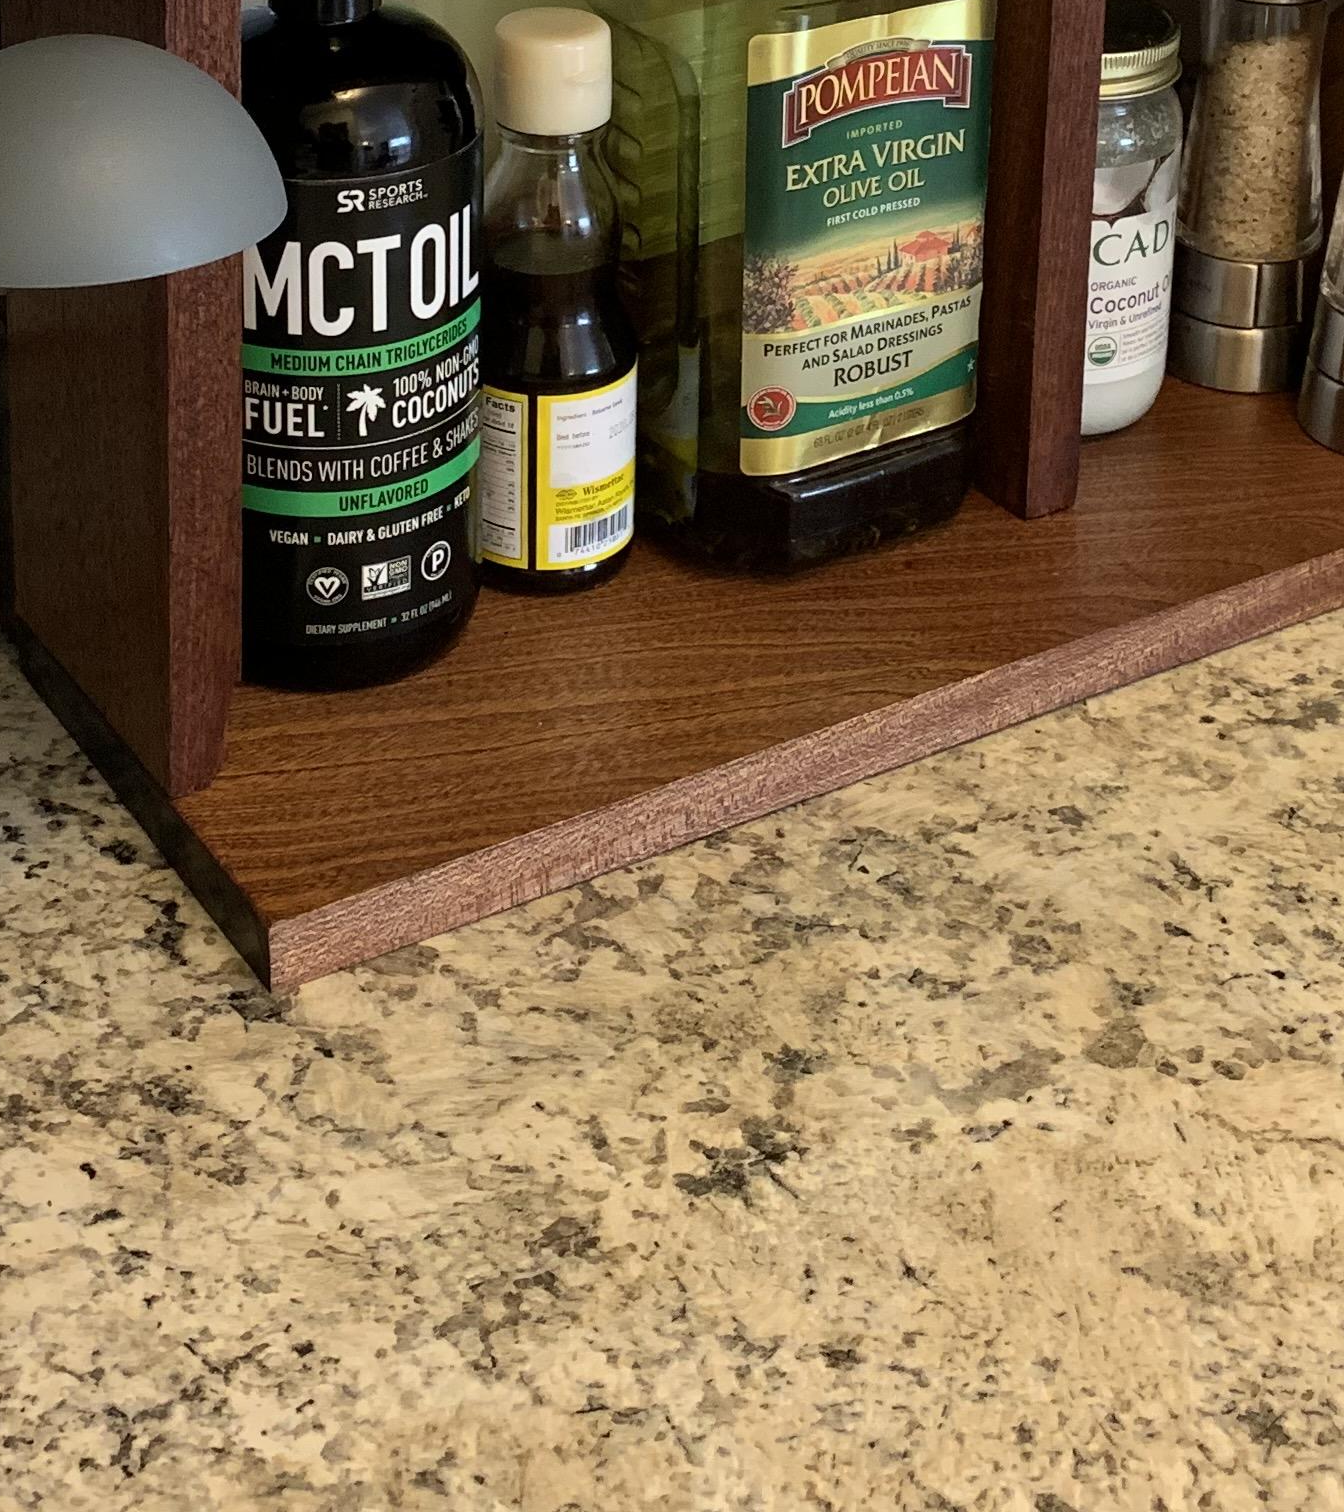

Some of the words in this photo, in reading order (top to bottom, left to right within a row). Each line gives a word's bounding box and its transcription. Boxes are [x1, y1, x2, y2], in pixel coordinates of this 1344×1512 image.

[799, 52, 960, 125] POMPEIAN
[846, 120, 903, 139] IMPORTED
[785, 149, 867, 192] EXTRA
[871, 129, 966, 168] VIRGIN
[336, 189, 366, 213] SR
[368, 178, 423, 201] SPORTS
[368, 193, 423, 210] RESEARCH
[823, 176, 883, 208] OLIVE
[888, 168, 926, 192] OIL
[827, 212, 852, 227] FIRST
[852, 205, 878, 220] COLD
[880, 197, 921, 214] PRESSED
[243, 234, 401, 337] MCT
[410, 203, 479, 320] OIL
[1090, 276, 1138, 292] ORGANIC
[1090, 282, 1160, 315] Coconut
[764, 338, 822, 357] PERFECT
[824, 332, 848, 348] FOR
[850, 311, 929, 340] MARINADES,
[931, 296, 971, 319] PASTAS
[1088, 319, 1118, 330] Virgin
[1119, 315, 1126, 325] &
[271, 352, 330, 372] MEDIUM
[335, 351, 382, 372] CHAIN
[386, 318, 467, 365] TRIGLYCERIDES
[802, 355, 830, 371] AND
[832, 342, 874, 362] SALAD
[877, 324, 943, 351] DRESSINGS
[393, 368, 432, 397] 100%
[436, 335, 479, 381] NON-GMO
[833, 350, 913, 387] ROBUST
[244, 379, 280, 399] BRAIN
[292, 385, 324, 401] BODY
[392, 357, 479, 429] COCONUTS
[485, 397, 516, 413] Facts
[828, 404, 856, 419] Acidity
[858, 397, 874, 410] less
[875, 392, 893, 405] than
[247, 453, 313, 482] BLENDS
[318, 459, 364, 481] WITH
[370, 442, 429, 478] COFFEE
[433, 437, 443, 459] &
[446, 407, 479, 451] SHAKES
[339, 478, 429, 512] UNFLAVORED
[269, 529, 309, 546] VEGAN
[327, 529, 364, 546] DAIRY
[366, 528, 376, 542] &
[378, 515, 420, 540] GLUTEN
[421, 505, 444, 527] FREE
[453, 486, 471, 510] KETO
[306, 624, 336, 635] DIETARY
[338, 617, 387, 634] SUPPLEMENT
